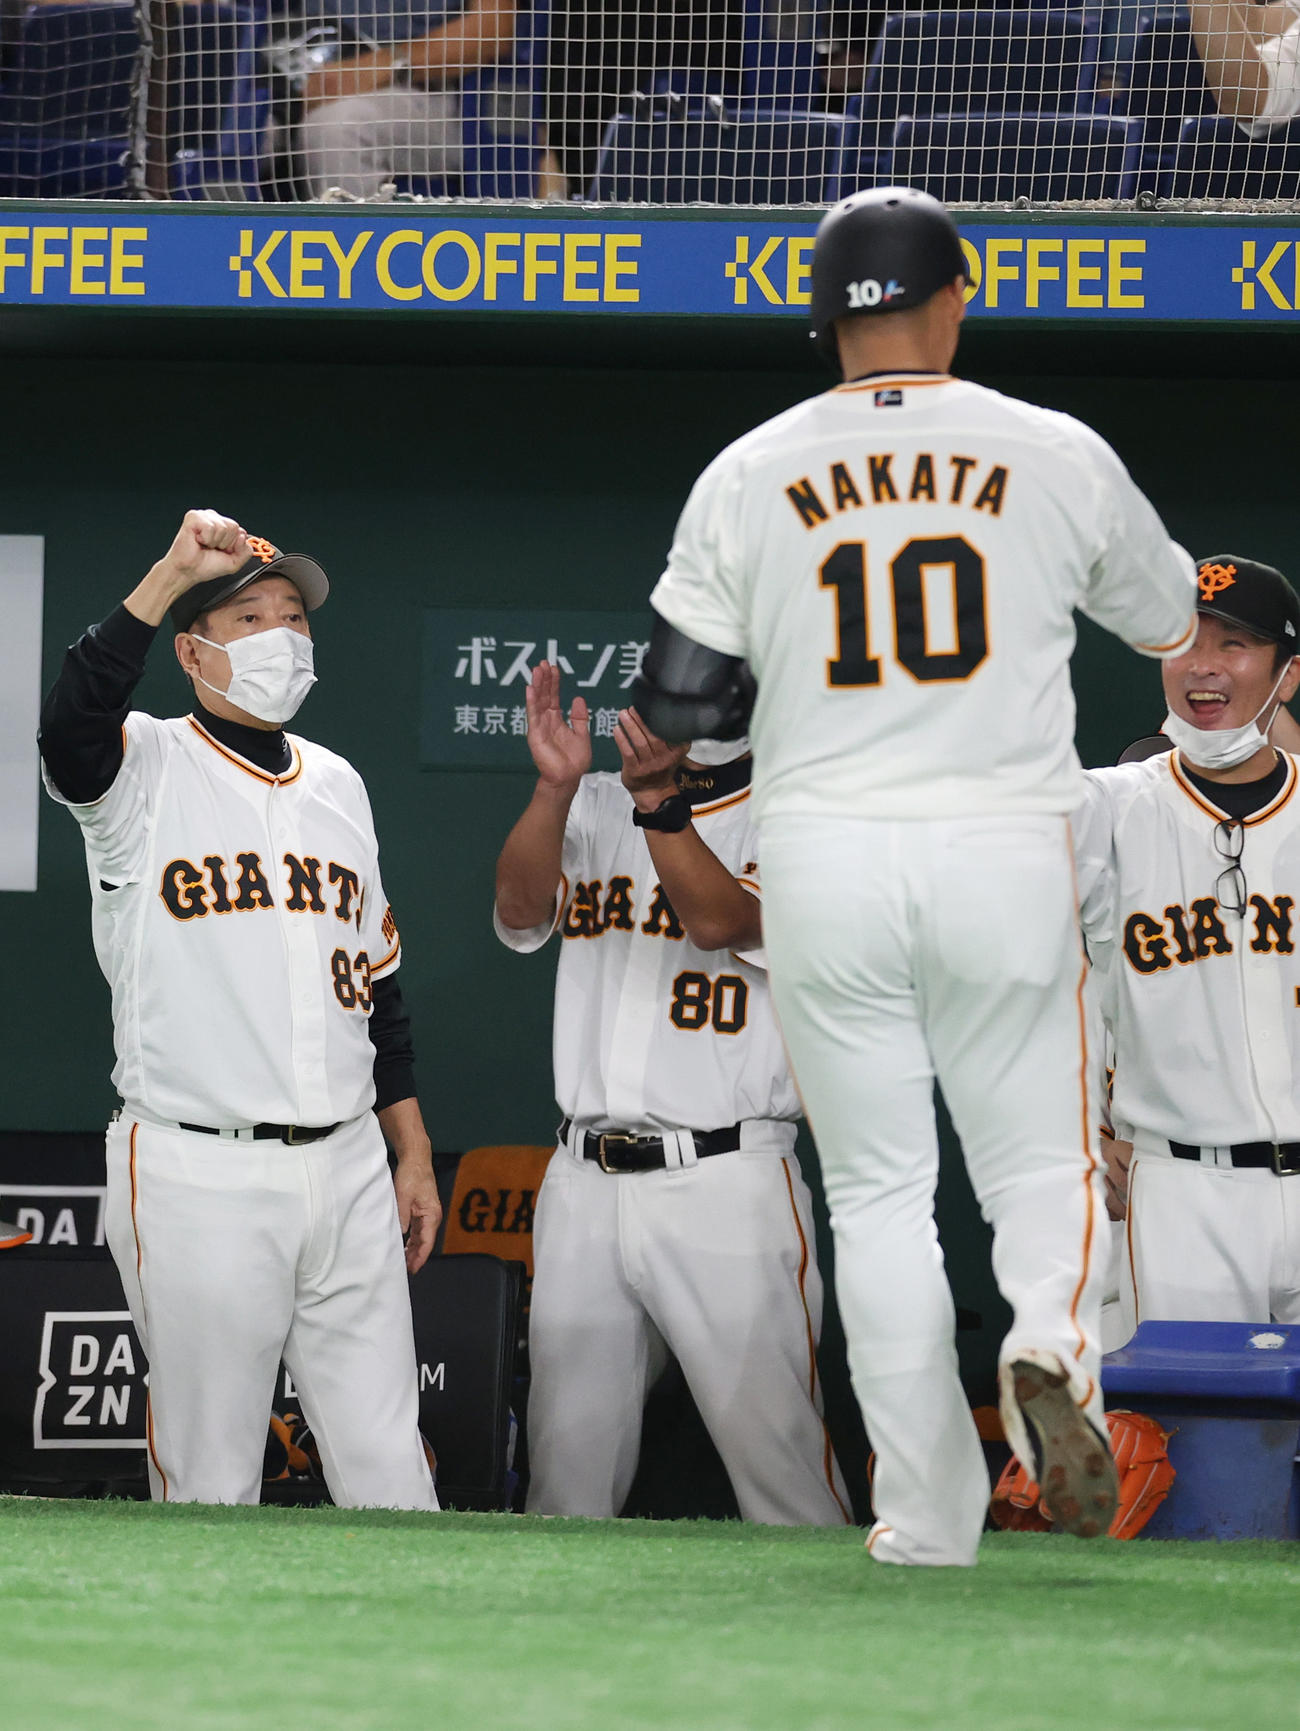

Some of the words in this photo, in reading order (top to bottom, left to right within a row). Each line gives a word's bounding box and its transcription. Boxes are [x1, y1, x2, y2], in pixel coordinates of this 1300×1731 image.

[846, 279, 883, 308] 10
[1231, 240, 1300, 310] K
[785, 453, 1011, 531] NAKATA
[817, 532, 992, 690] 10
[159, 851, 366, 923] GIANT
[331, 947, 373, 1014] 83
[669, 969, 748, 1036] 80
[17, 1207, 79, 1246] DA
